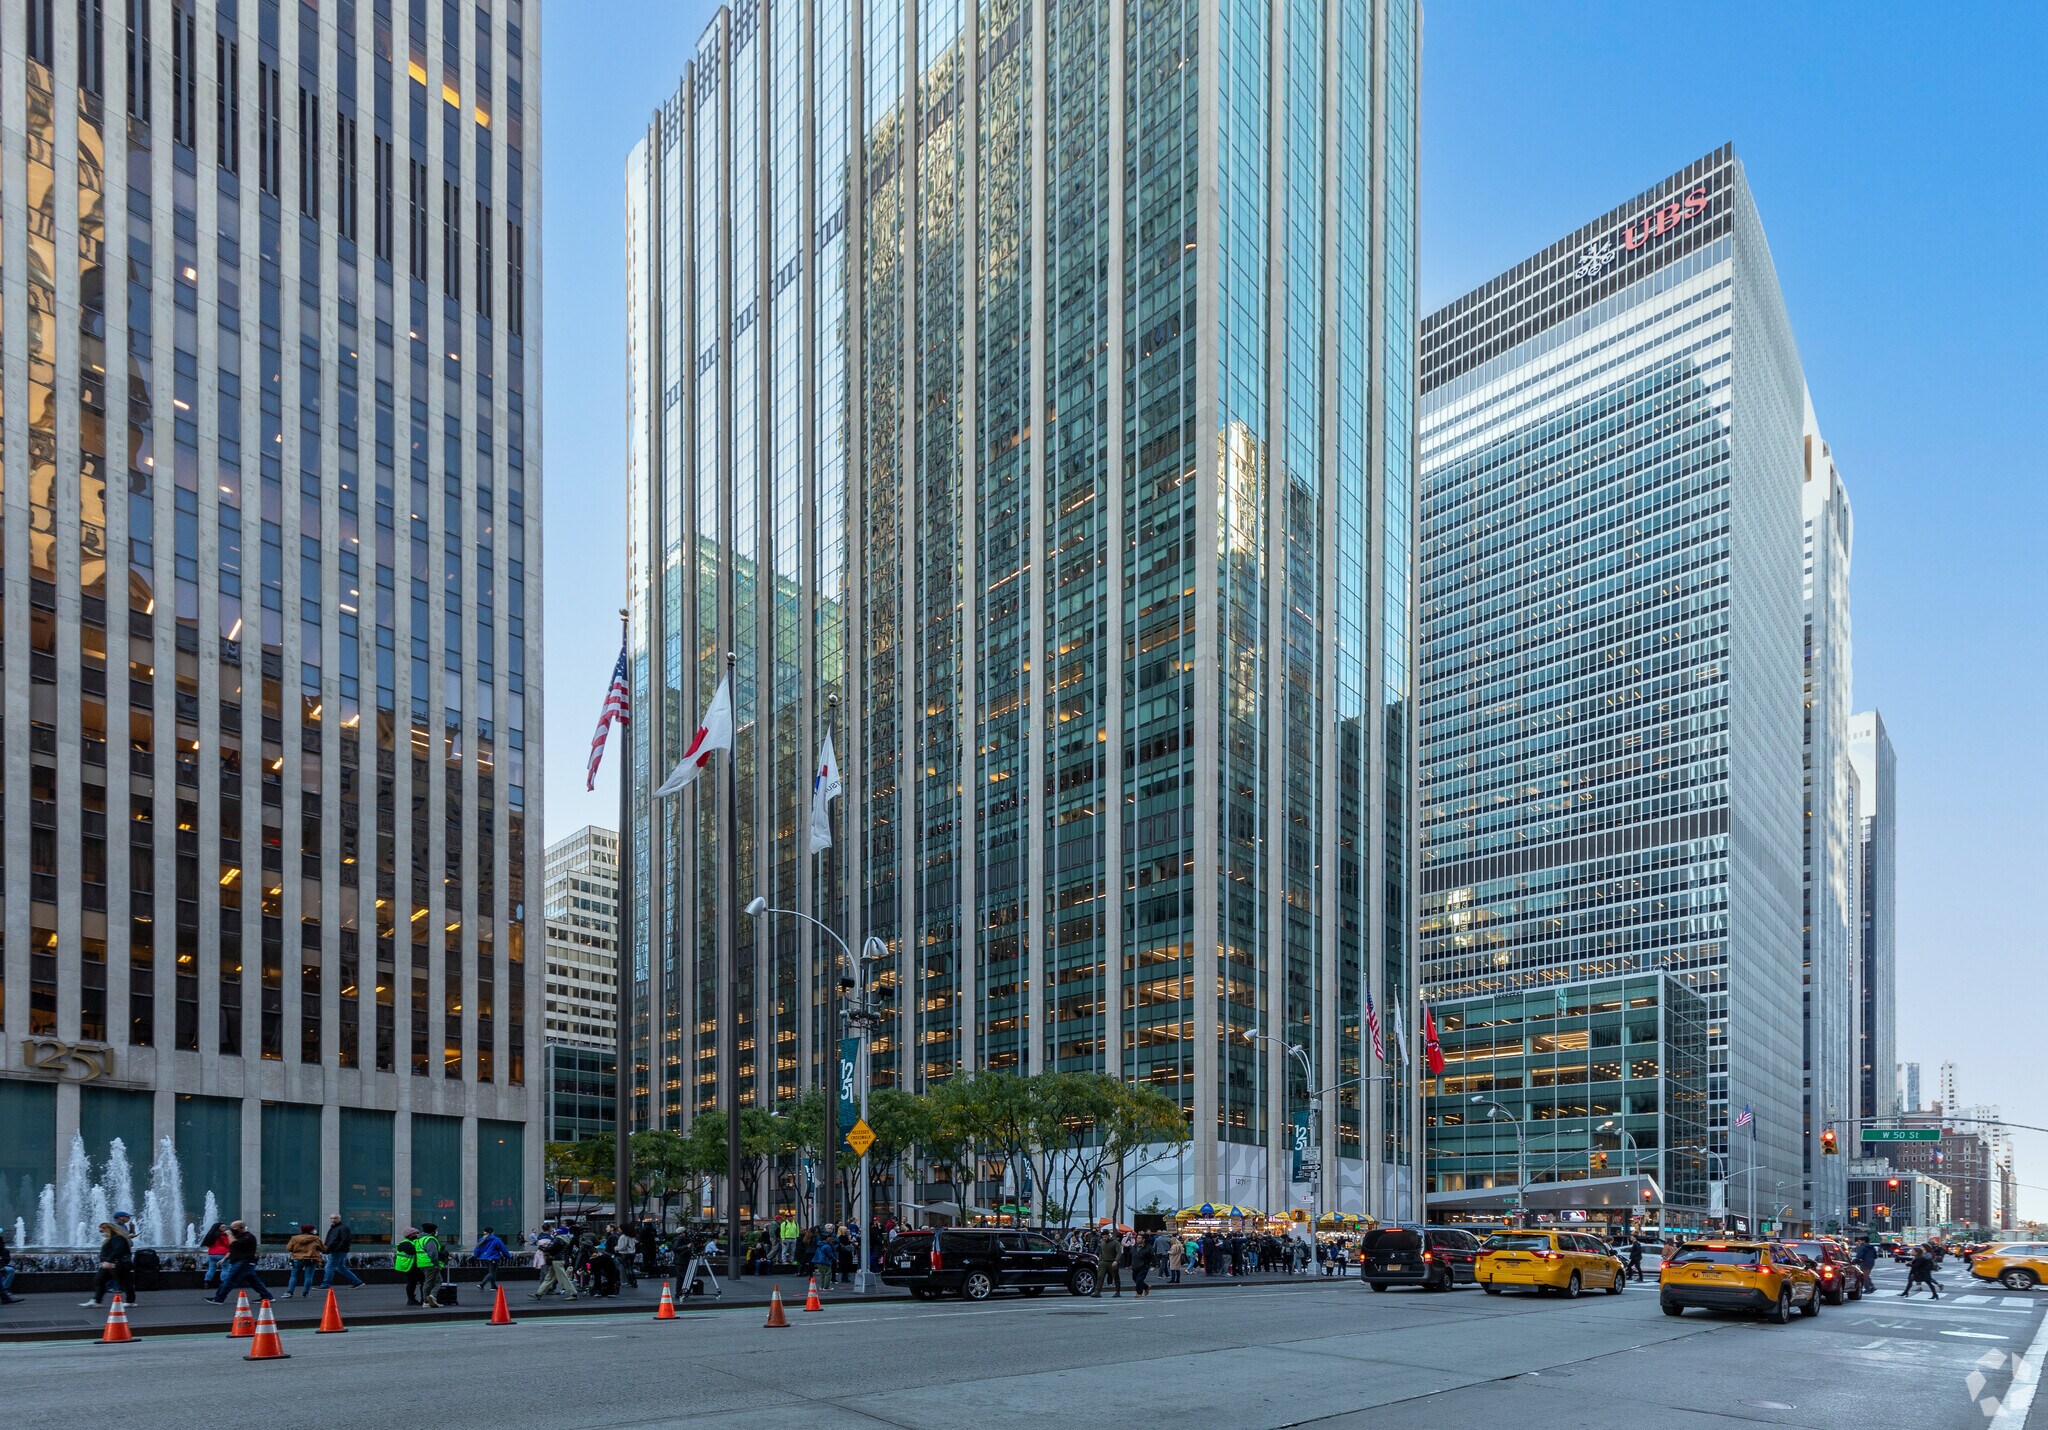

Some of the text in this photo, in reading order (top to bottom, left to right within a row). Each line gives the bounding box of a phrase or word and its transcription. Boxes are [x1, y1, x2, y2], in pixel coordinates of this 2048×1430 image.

[1621, 186, 1708, 251] UBS
[21, 1039, 115, 1081] 1251
[1882, 1131, 1919, 1139] W 50 St
